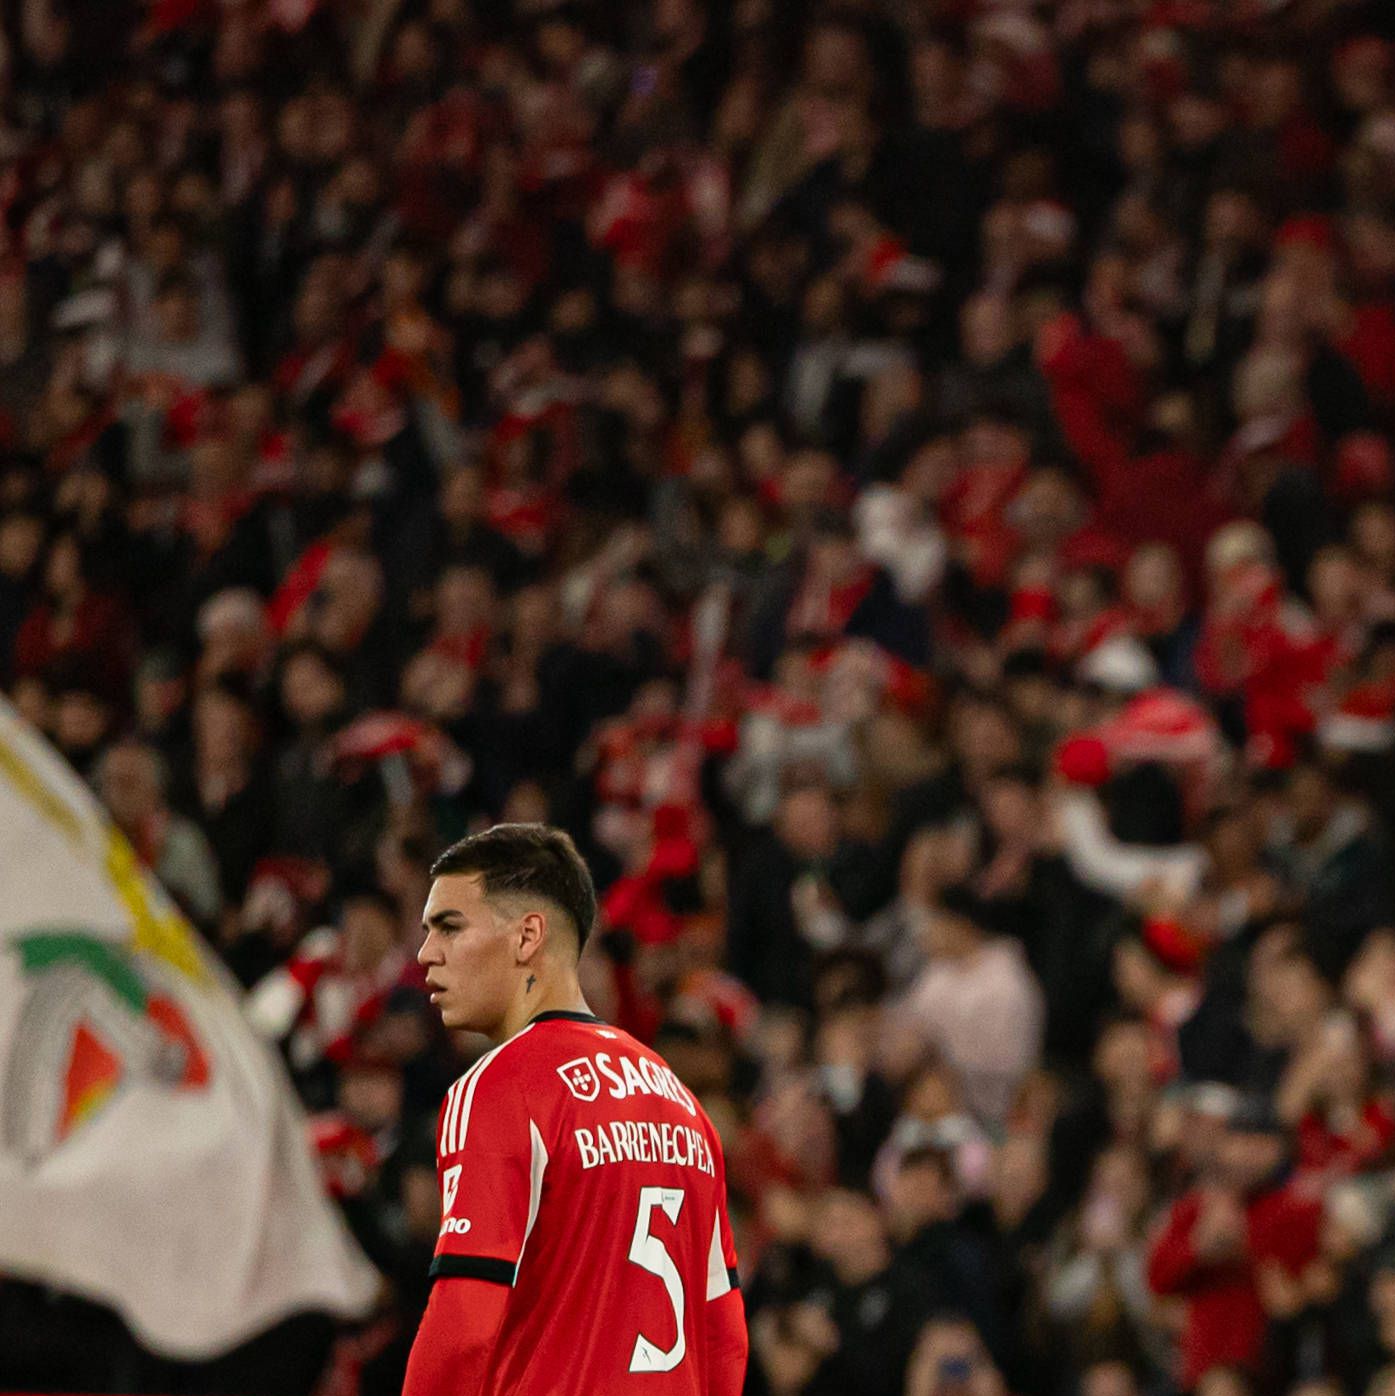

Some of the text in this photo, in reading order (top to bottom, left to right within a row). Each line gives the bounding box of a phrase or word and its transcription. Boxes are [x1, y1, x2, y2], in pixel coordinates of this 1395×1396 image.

[595, 1052, 697, 1117] SAGRES
[574, 1121, 716, 1178] BARRENECHEA
[628, 1186, 687, 1373] 5
